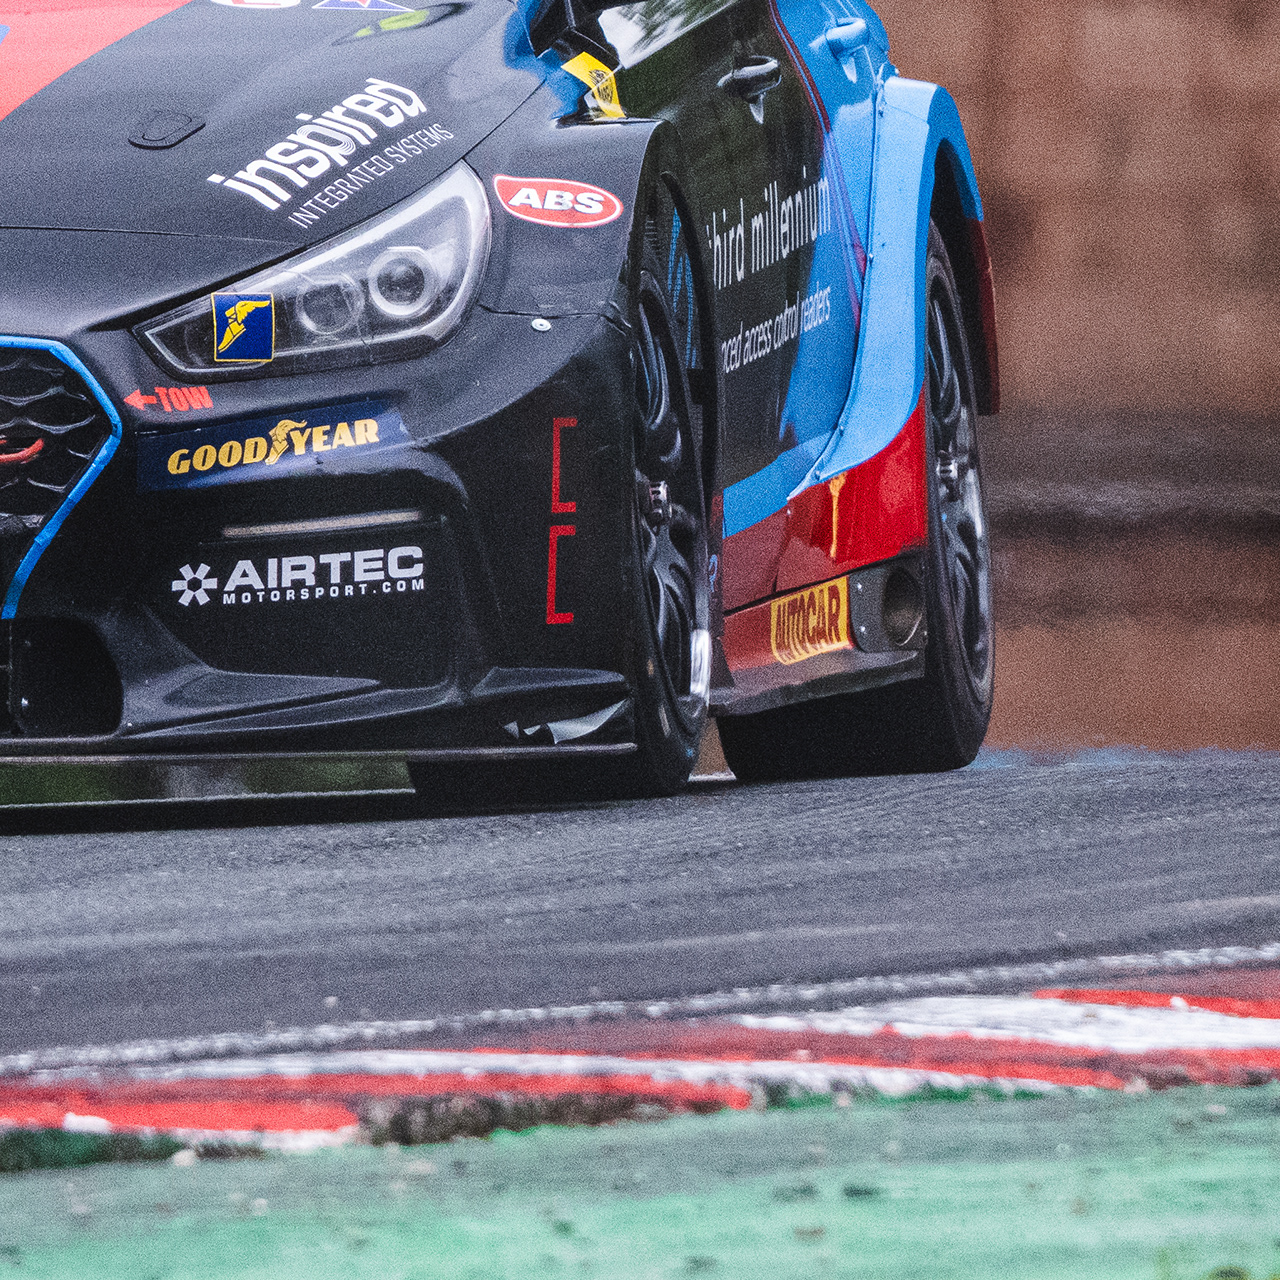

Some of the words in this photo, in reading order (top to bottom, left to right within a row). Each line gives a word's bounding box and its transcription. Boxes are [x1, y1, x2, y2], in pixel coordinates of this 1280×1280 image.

[208, 78, 428, 211] inspired
[288, 155, 393, 229] INTEGRATED
[384, 123, 455, 175] SYSTEMS
[507, 187, 605, 213] ABS
[751, 165, 831, 273] millennium
[743, 318, 772, 366] access
[773, 291, 799, 350] control
[800, 281, 831, 334] readers
[156, 386, 214, 412] TOW
[167, 418, 380, 475] GOODYEAR
[223, 546, 425, 590] AIRTEC
[223, 576, 426, 606] MOTORSPORT.COM
